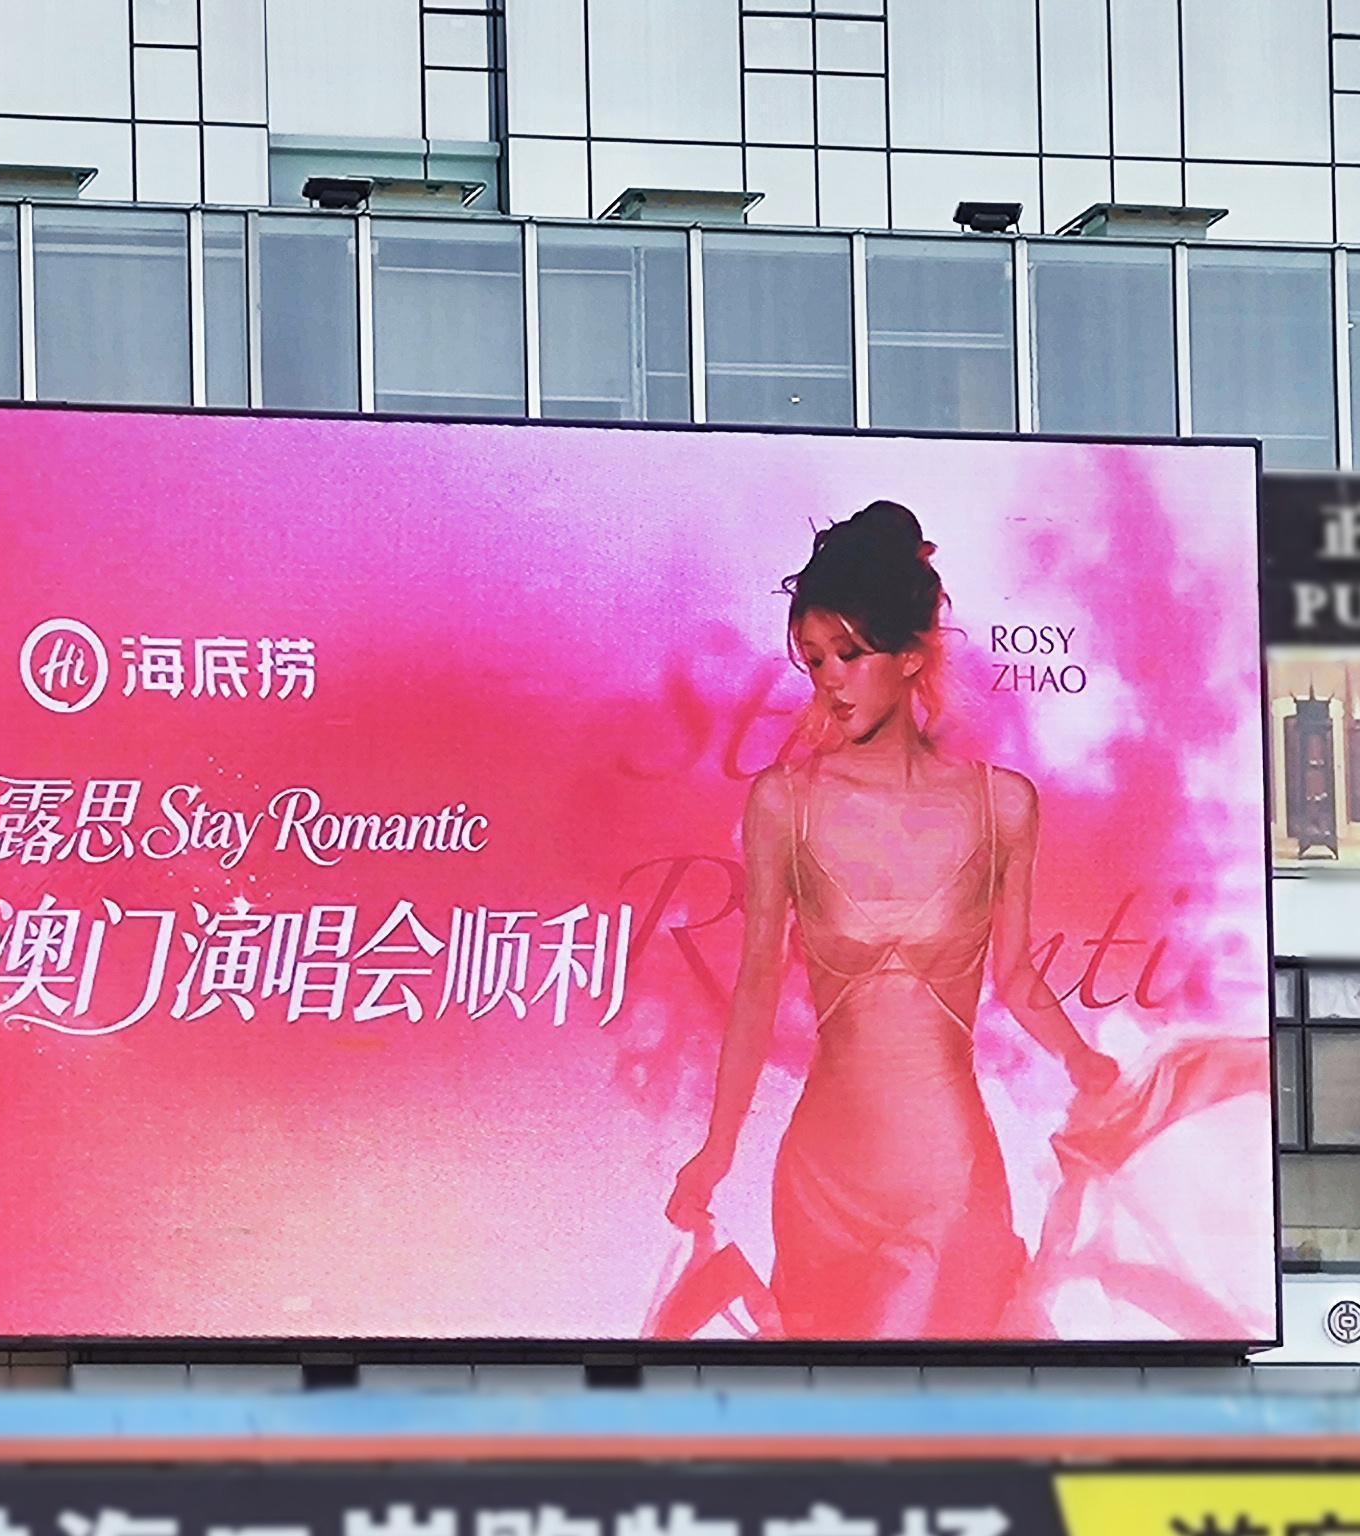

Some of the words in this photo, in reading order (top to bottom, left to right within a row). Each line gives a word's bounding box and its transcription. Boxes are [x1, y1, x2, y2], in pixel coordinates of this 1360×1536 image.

[991, 625, 1077, 656] ROSY
[121, 633, 318, 701] 海底捞
[991, 665, 1087, 695] ZHAO
[141, 783, 263, 868] Stay
[266, 786, 489, 867] Romantic
